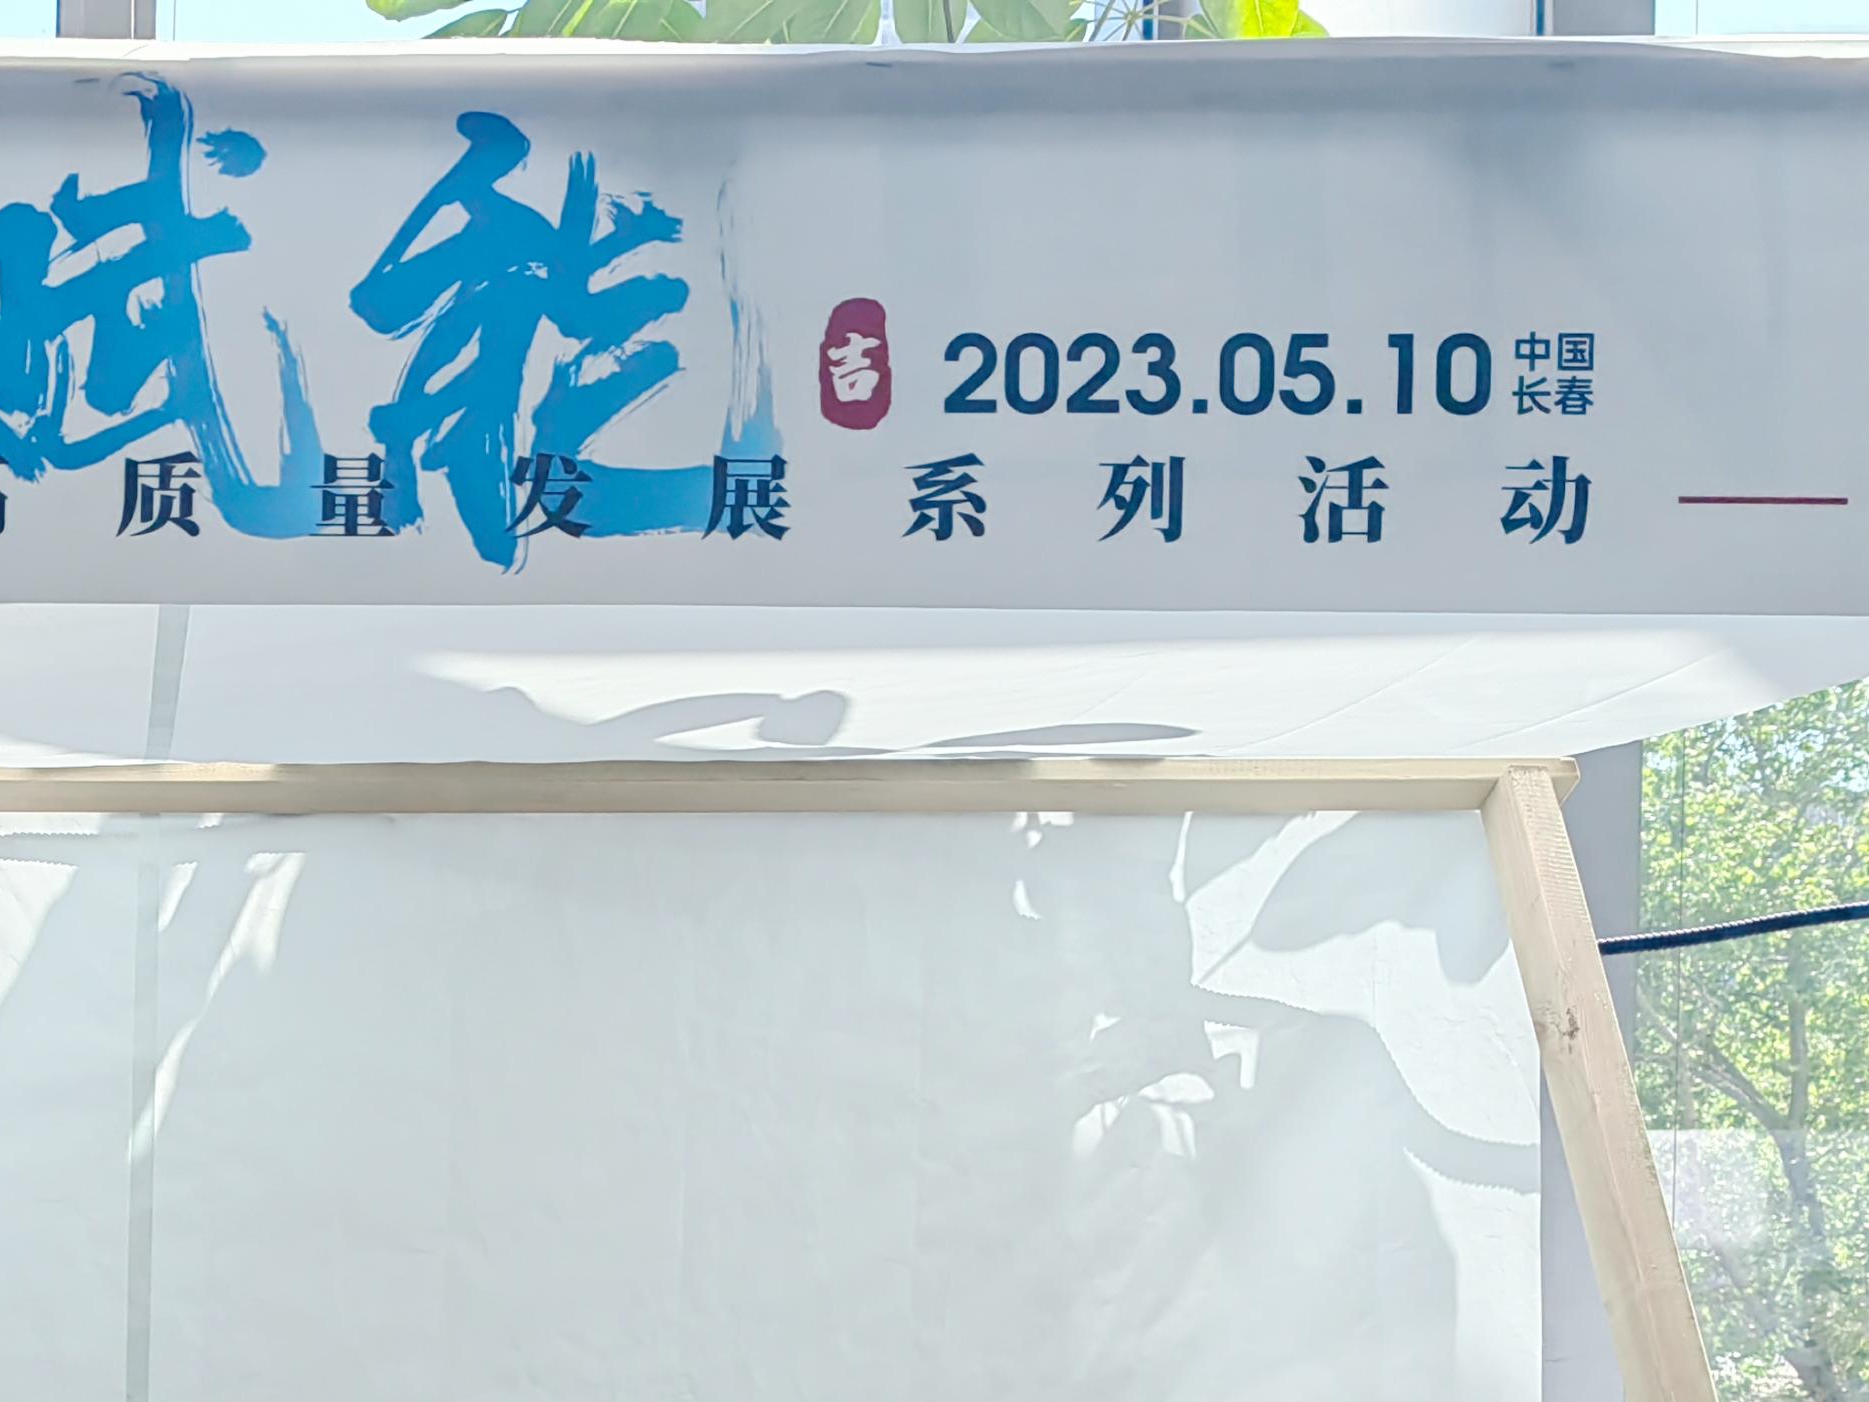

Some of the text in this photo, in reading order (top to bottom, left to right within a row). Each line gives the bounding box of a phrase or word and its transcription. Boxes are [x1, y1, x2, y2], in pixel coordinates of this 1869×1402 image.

[1513, 331, 1595, 372] 中国
[943, 332, 1492, 416] 2023.05.10
[1512, 376, 1595, 417] 长春
